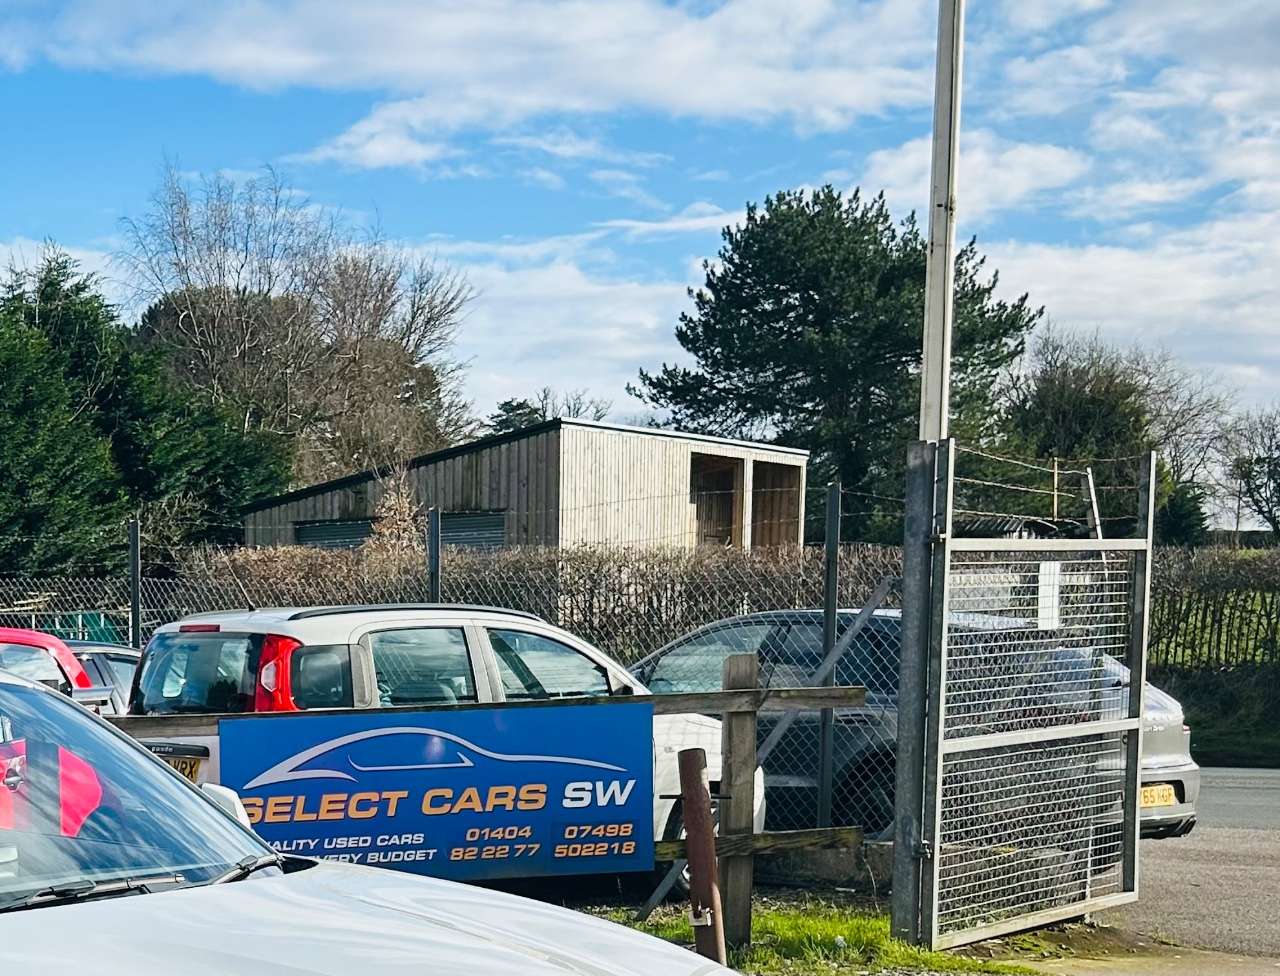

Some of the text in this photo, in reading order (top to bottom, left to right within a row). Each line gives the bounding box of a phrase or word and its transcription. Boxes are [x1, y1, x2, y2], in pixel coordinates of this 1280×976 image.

[240, 779, 637, 824] SELECT CARS SW
[323, 836, 372, 849] USED
[376, 833, 425, 847] CARS
[465, 823, 634, 842] 01404 07498
[367, 849, 438, 864] BUDGET
[554, 841, 636, 858] 502218
